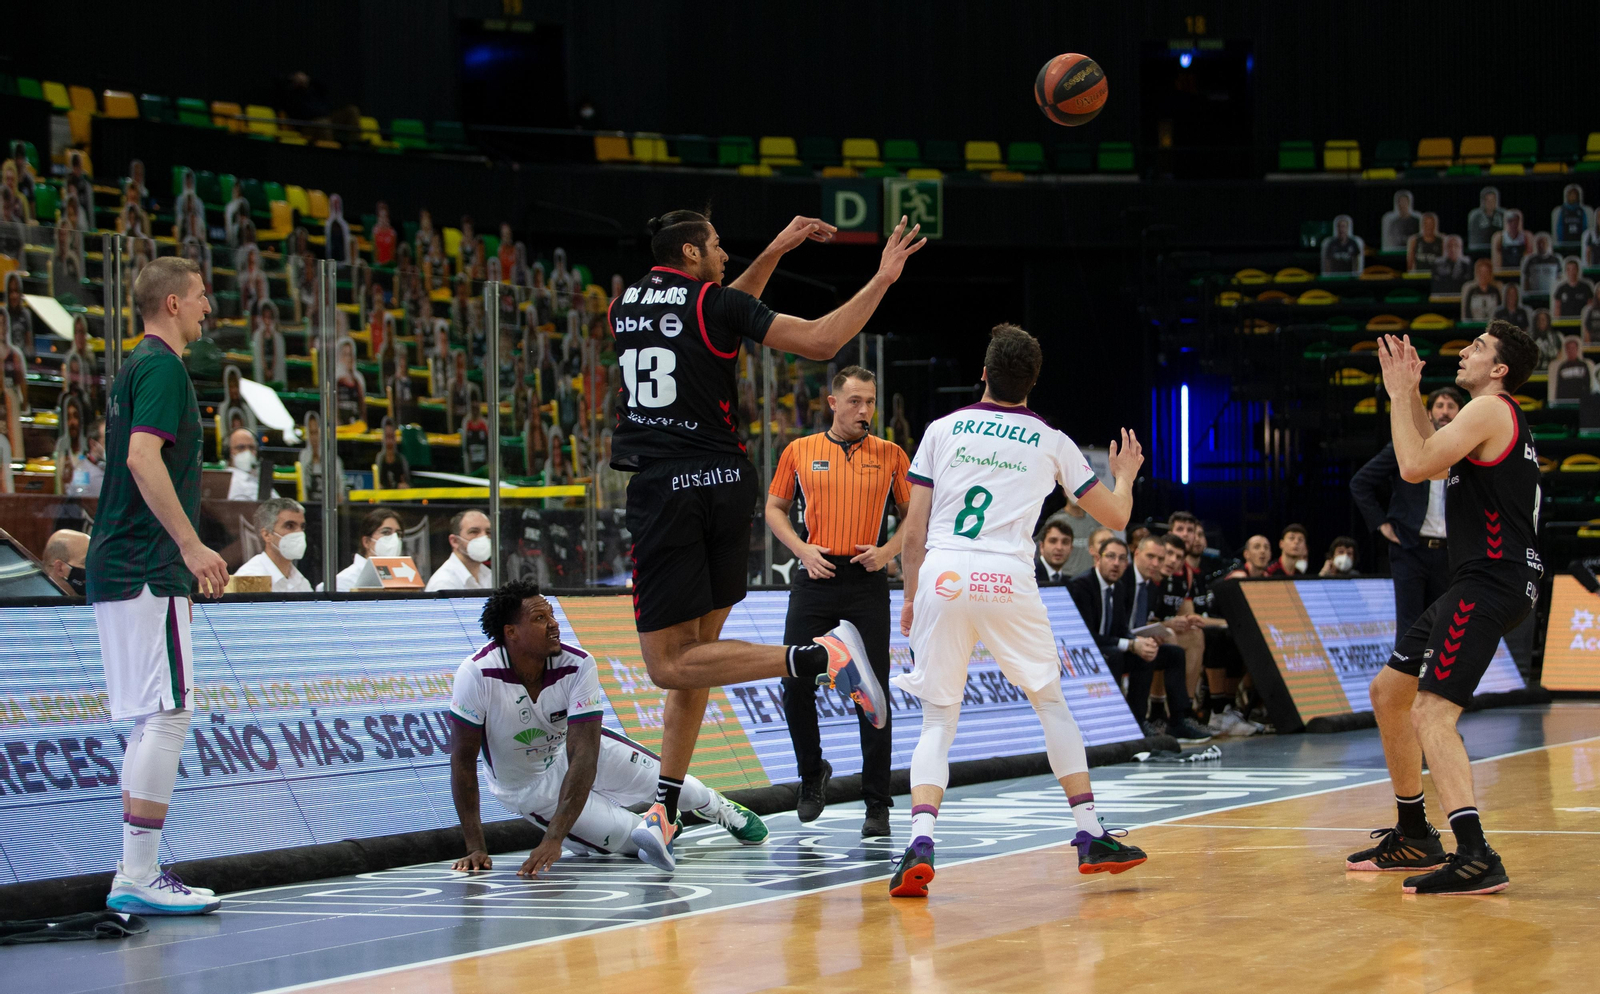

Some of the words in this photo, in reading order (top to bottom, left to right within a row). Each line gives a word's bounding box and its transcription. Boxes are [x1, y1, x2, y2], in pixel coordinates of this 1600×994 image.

[835, 190, 868, 228] D
[641, 286, 688, 306] ANJOS
[615, 316, 654, 333] bbk
[618, 346, 678, 409] 13
[952, 419, 1042, 448] BRIZUELA
[953, 485, 994, 540] 8
[969, 583, 991, 593] DEL
[992, 585, 1014, 594] SOL
[970, 571, 1013, 586] COSTA
[969, 592, 1014, 604] MÁLAGA
[732, 687, 773, 724] TE
[193, 713, 279, 777] AÑO
[278, 709, 364, 769] MÁS
[363, 710, 452, 760] SEGU
